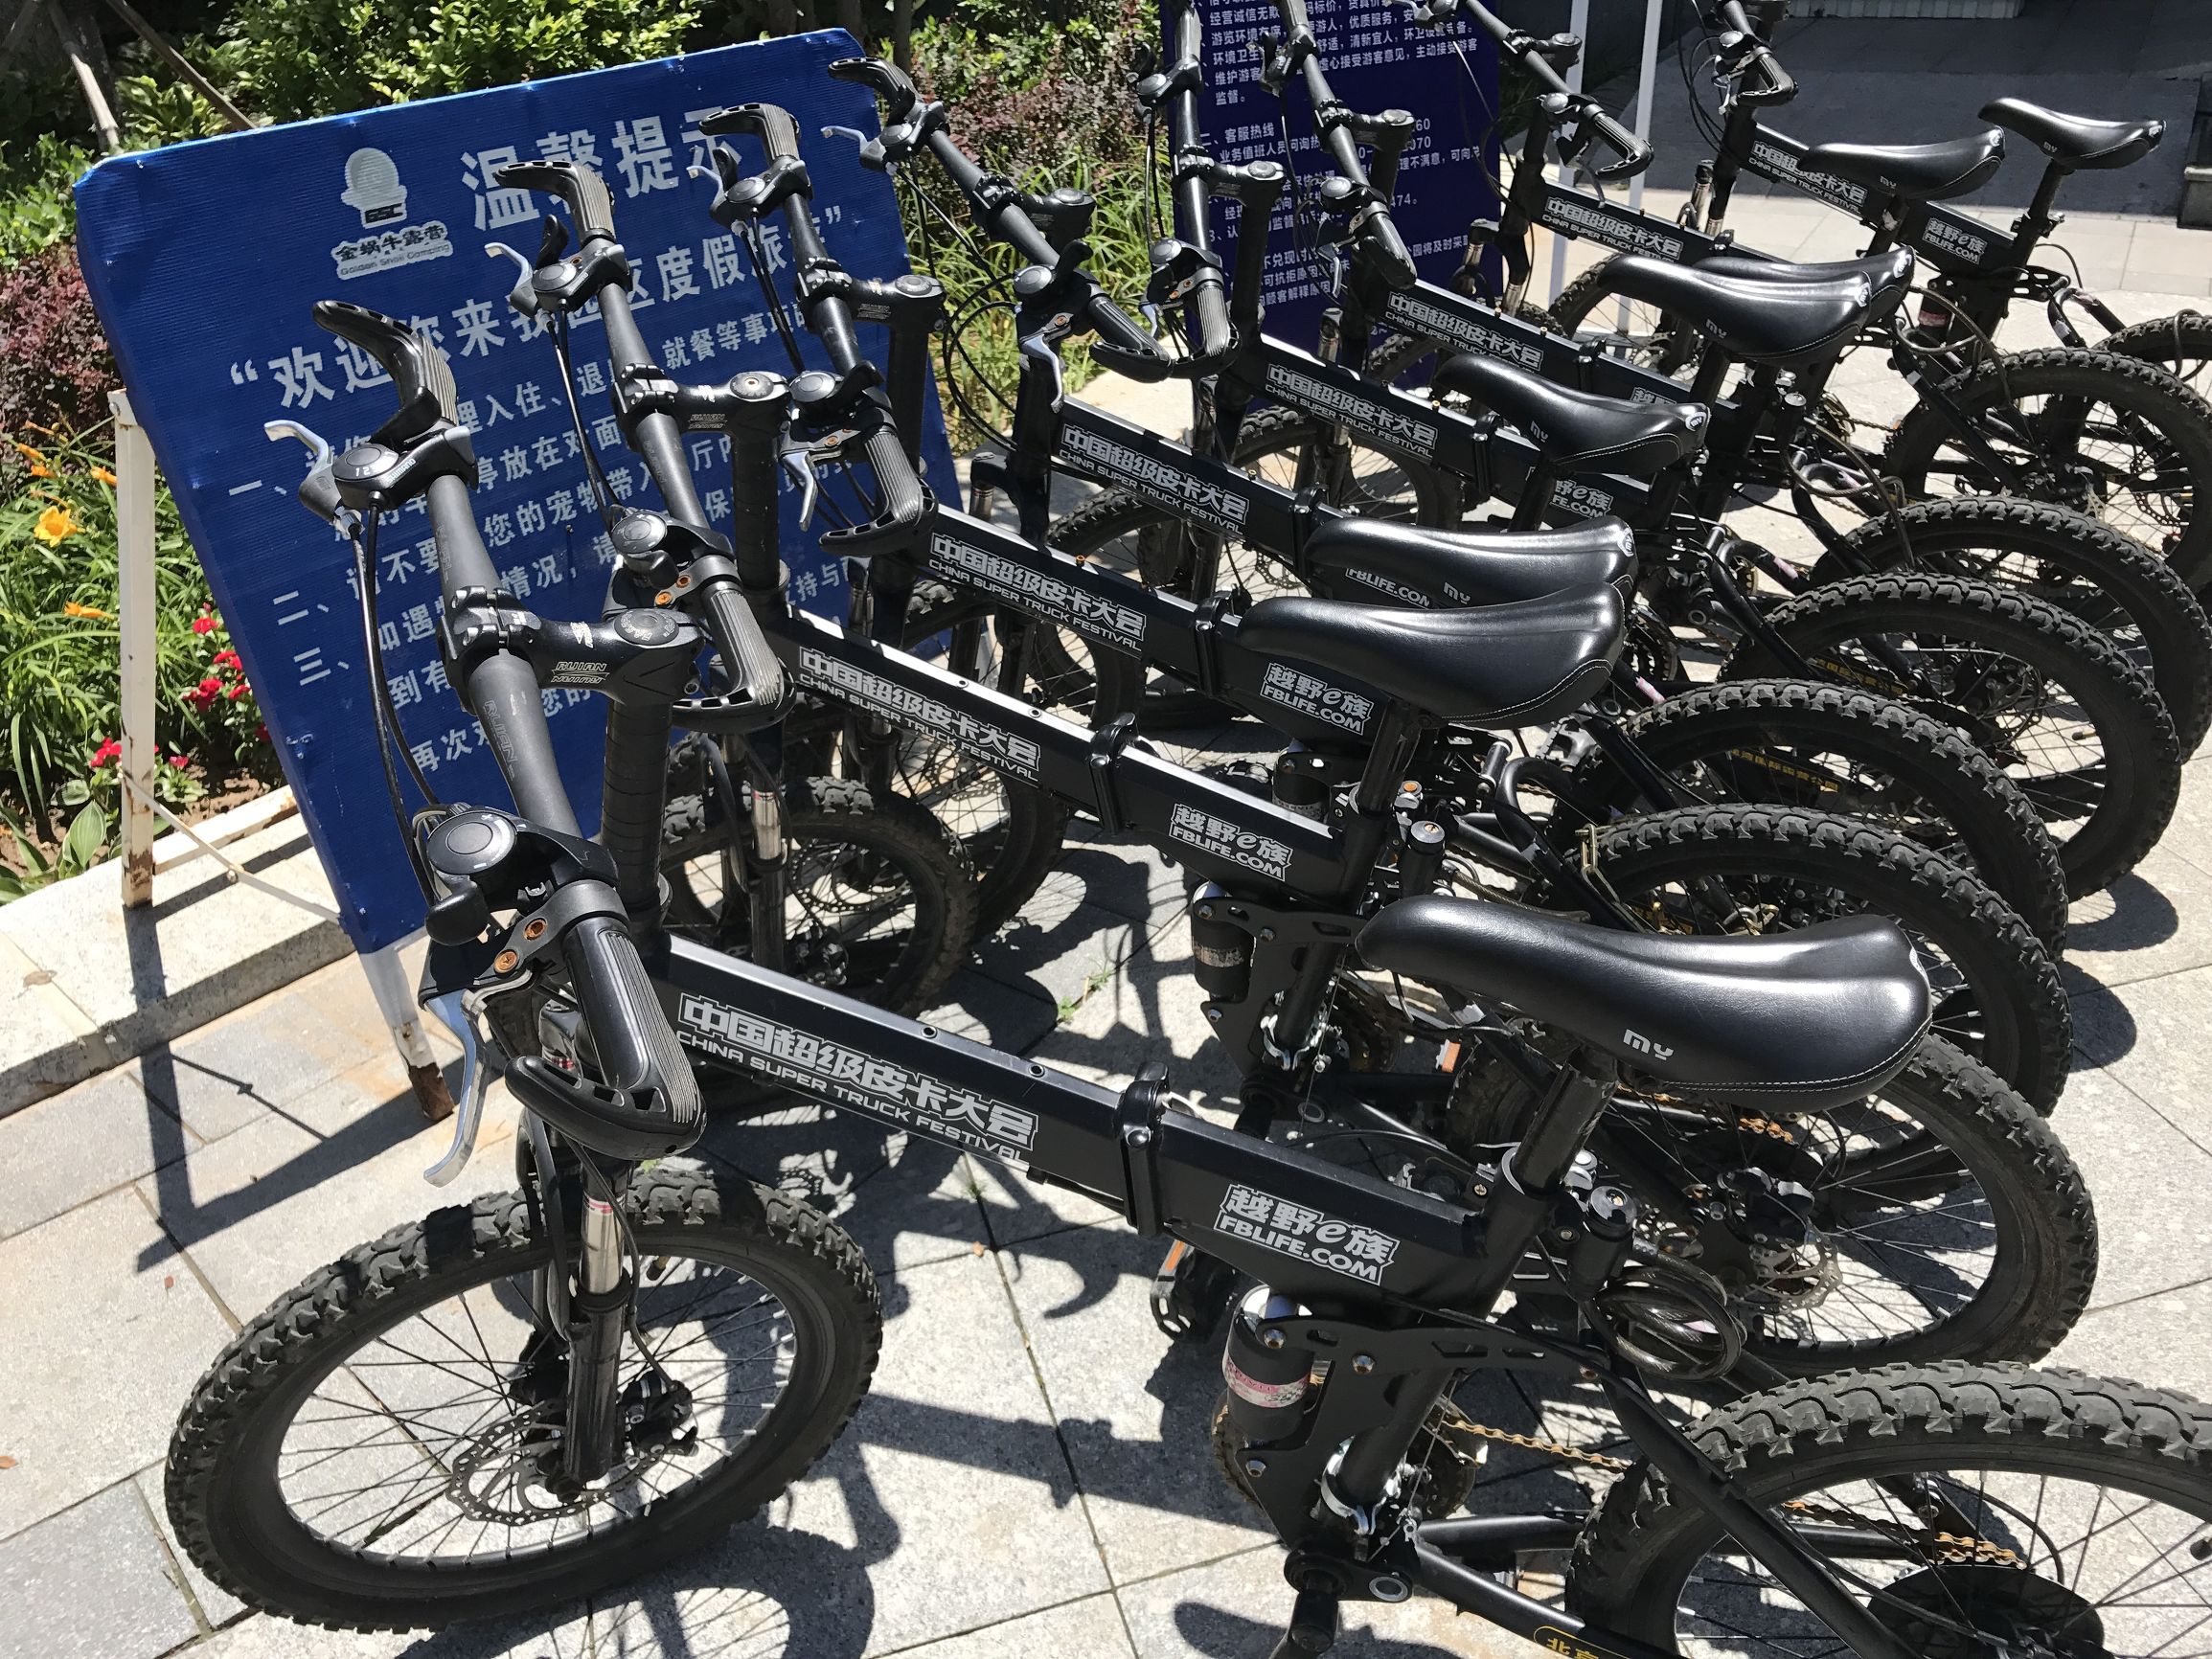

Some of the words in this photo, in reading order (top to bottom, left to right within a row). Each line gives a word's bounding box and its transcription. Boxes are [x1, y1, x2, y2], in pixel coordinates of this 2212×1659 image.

[1748, 157, 1771, 172] CHINA
[1771, 169, 1797, 184] SUPER
[1798, 180, 1823, 197] TRUCK
[1823, 192, 1861, 215] FESTIVAL
[1542, 214, 1570, 229] CHINA
[1570, 223, 1600, 240] SUPER
[1602, 235, 1632, 252] TRUCK
[1545, 196, 1683, 261] 中国超级皮卡大会
[1923, 233, 1979, 263] FBLIFE.COM
[1385, 311, 1415, 329] CHINA
[1417, 324, 1451, 343] SUPER
[1453, 338, 1487, 355] TRUCK
[1388, 291, 1543, 372] 中国超级皮卡大会
[1266, 384, 1298, 404] CHINA
[1299, 398, 1338, 421] SUPER
[1339, 413, 1378, 437] TRUCK
[1378, 427, 1433, 459] FESTIVAL
[1267, 363, 1438, 450] 中国超级皮卡大会
[1059, 449, 1096, 472] CHINA
[1097, 465, 1138, 490] SUPER
[1139, 481, 1182, 510] TRUCK
[1182, 500, 1244, 535] FESTIVAL
[1061, 423, 1250, 525] 中国超级皮卡大会
[928, 558, 971, 584] CHINA
[972, 577, 1021, 605] SUPER
[1023, 596, 1071, 626] TRUCK
[1071, 615, 1143, 652] FESTIVAL
[931, 533, 1147, 642] 中国超级皮卡大会
[799, 646, 1042, 771] 中国超级皮卡大会
[800, 673, 847, 698] CHINA
[849, 693, 901, 725] SUPER
[904, 714, 958, 747] TRUCK
[960, 739, 1039, 782] FESTIVAL
[1261, 683, 1365, 736] FBLIFE.COM
[1266, 663, 1374, 719] 越野e族
[1169, 824, 1286, 881] FBLIFE.COM
[1172, 804, 1293, 866] 越野e族
[675, 1029, 744, 1063] CHINA
[749, 1056, 827, 1095] SUPER
[832, 1085, 910, 1124] TRUCK
[915, 1115, 1030, 1167] FESTIVAL
[679, 993, 1038, 1149] 中国超级皮卡大会
[1215, 1213, 1385, 1285] FBLIFE.COM
[1224, 1184, 1400, 1268] 越野e族
